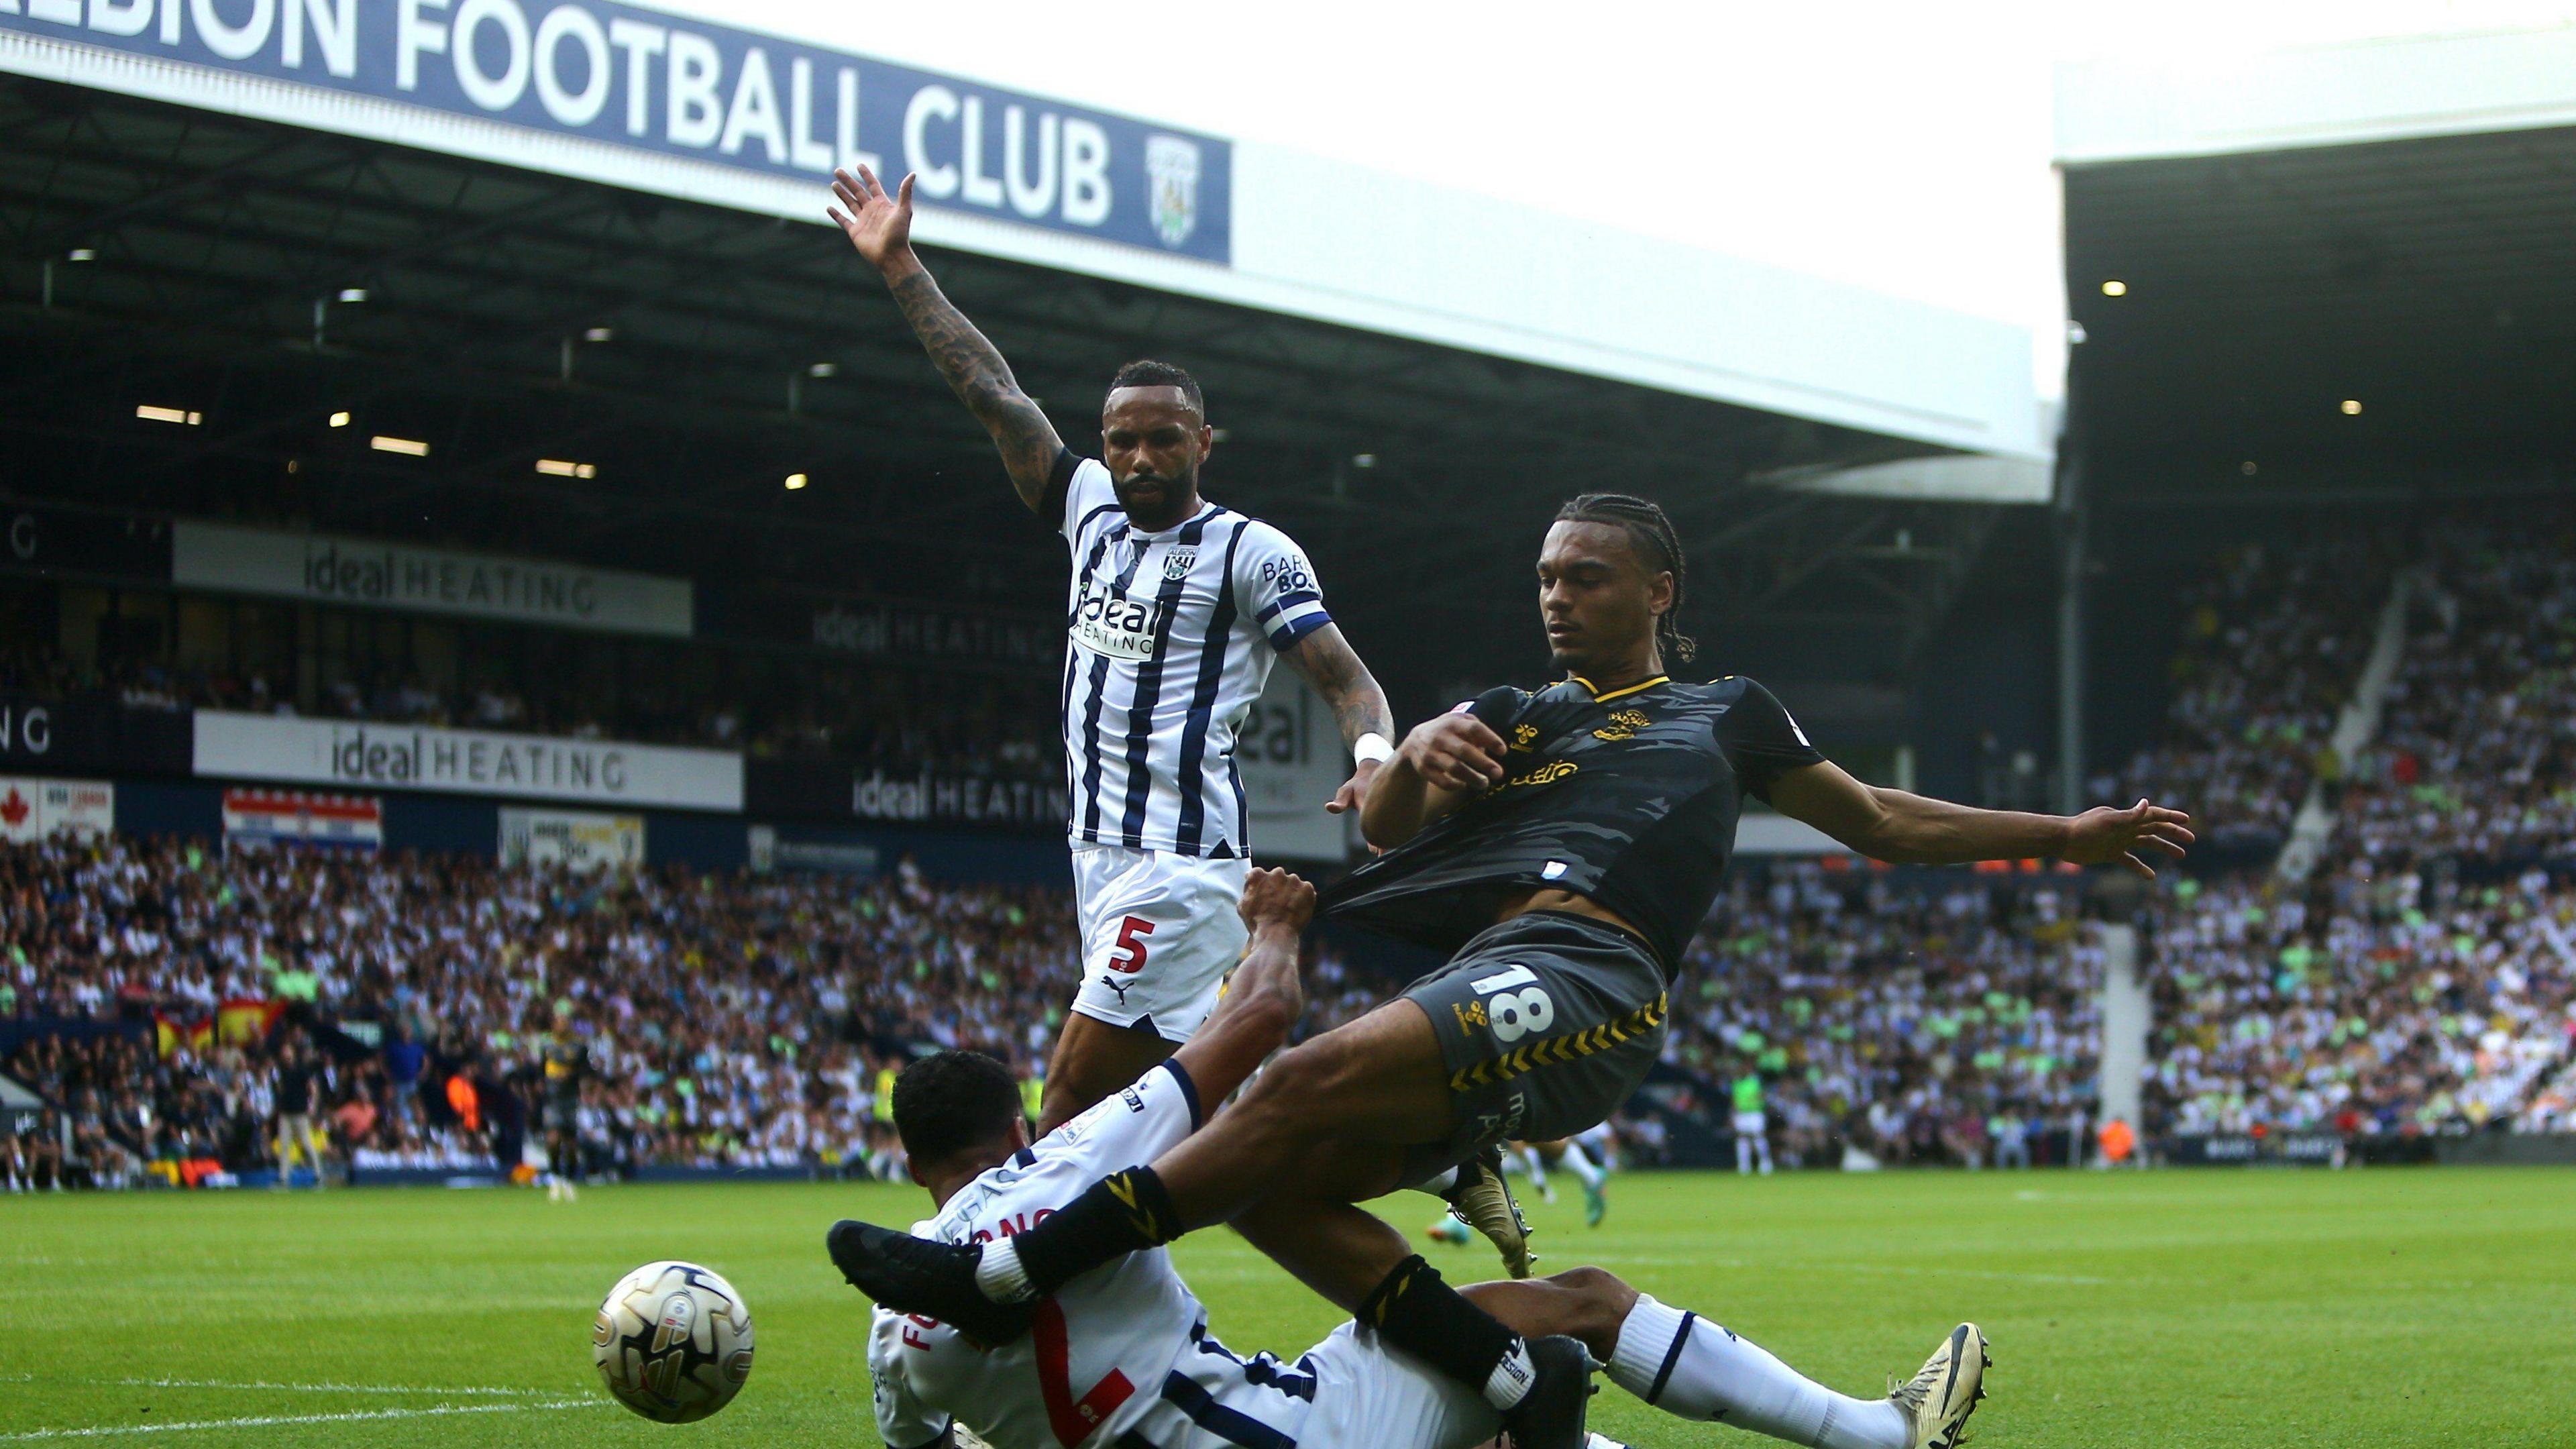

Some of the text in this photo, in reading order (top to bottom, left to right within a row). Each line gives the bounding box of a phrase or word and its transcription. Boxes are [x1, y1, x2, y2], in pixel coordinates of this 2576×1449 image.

[396, 0, 883, 180] FOOTBALL
[903, 85, 1112, 228] CLUB
[303, 543, 594, 615] ideal HEATING
[1073, 621, 1152, 654] HEATING
[1078, 582, 1161, 637] ideal
[331, 730, 628, 792] ideal HEATING
[852, 768, 930, 819] ideal
[1108, 916, 1155, 973] 5
[1469, 964, 1554, 1042] 18
